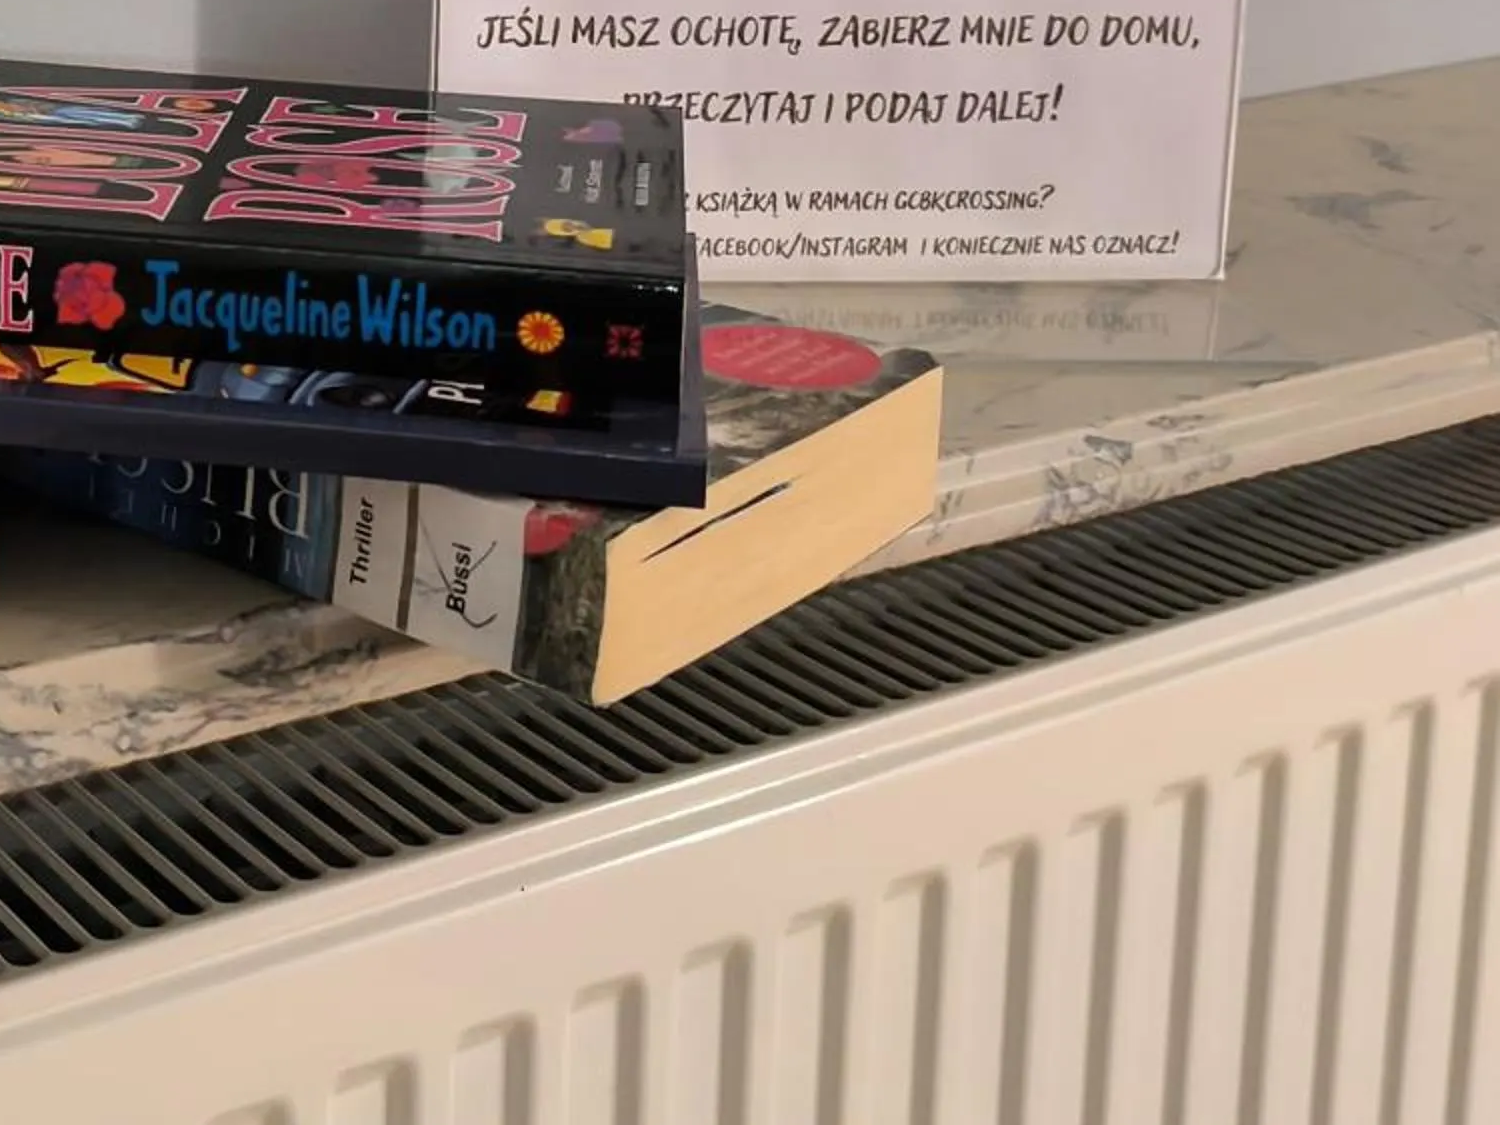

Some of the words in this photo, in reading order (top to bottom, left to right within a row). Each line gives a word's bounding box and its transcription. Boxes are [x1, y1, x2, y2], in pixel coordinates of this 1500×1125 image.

[476, 6, 561, 50] JEŚLI
[571, 14, 661, 49] MASZ
[669, 14, 803, 56] OCHOTĘ,
[817, 14, 951, 49] ZABIERZ
[959, 14, 1036, 48] MNIE
[1043, 13, 1090, 48] DO
[1099, 14, 1200, 50] DOMU,
[824, 92, 835, 124] I
[844, 90, 949, 125] PODAJ
[955, 82, 1065, 124] DALEJ!
[203, 95, 528, 243] ROSE
[695, 186, 779, 219] KSIĄŻKĄ
[784, 190, 804, 212] W
[808, 190, 890, 212] RAMACH
[893, 183, 1056, 213] GCBKCROSSING?
[920, 237, 927, 256] I
[932, 234, 1045, 258] KONIECZNIE
[1049, 234, 1087, 256] NAS
[1091, 229, 1181, 256] OZNACZ!
[140, 260, 351, 352] Jacqueline
[356, 272, 496, 351] Wilson
[349, 496, 375, 586] Thriller
[445, 541, 473, 615] Bussi
